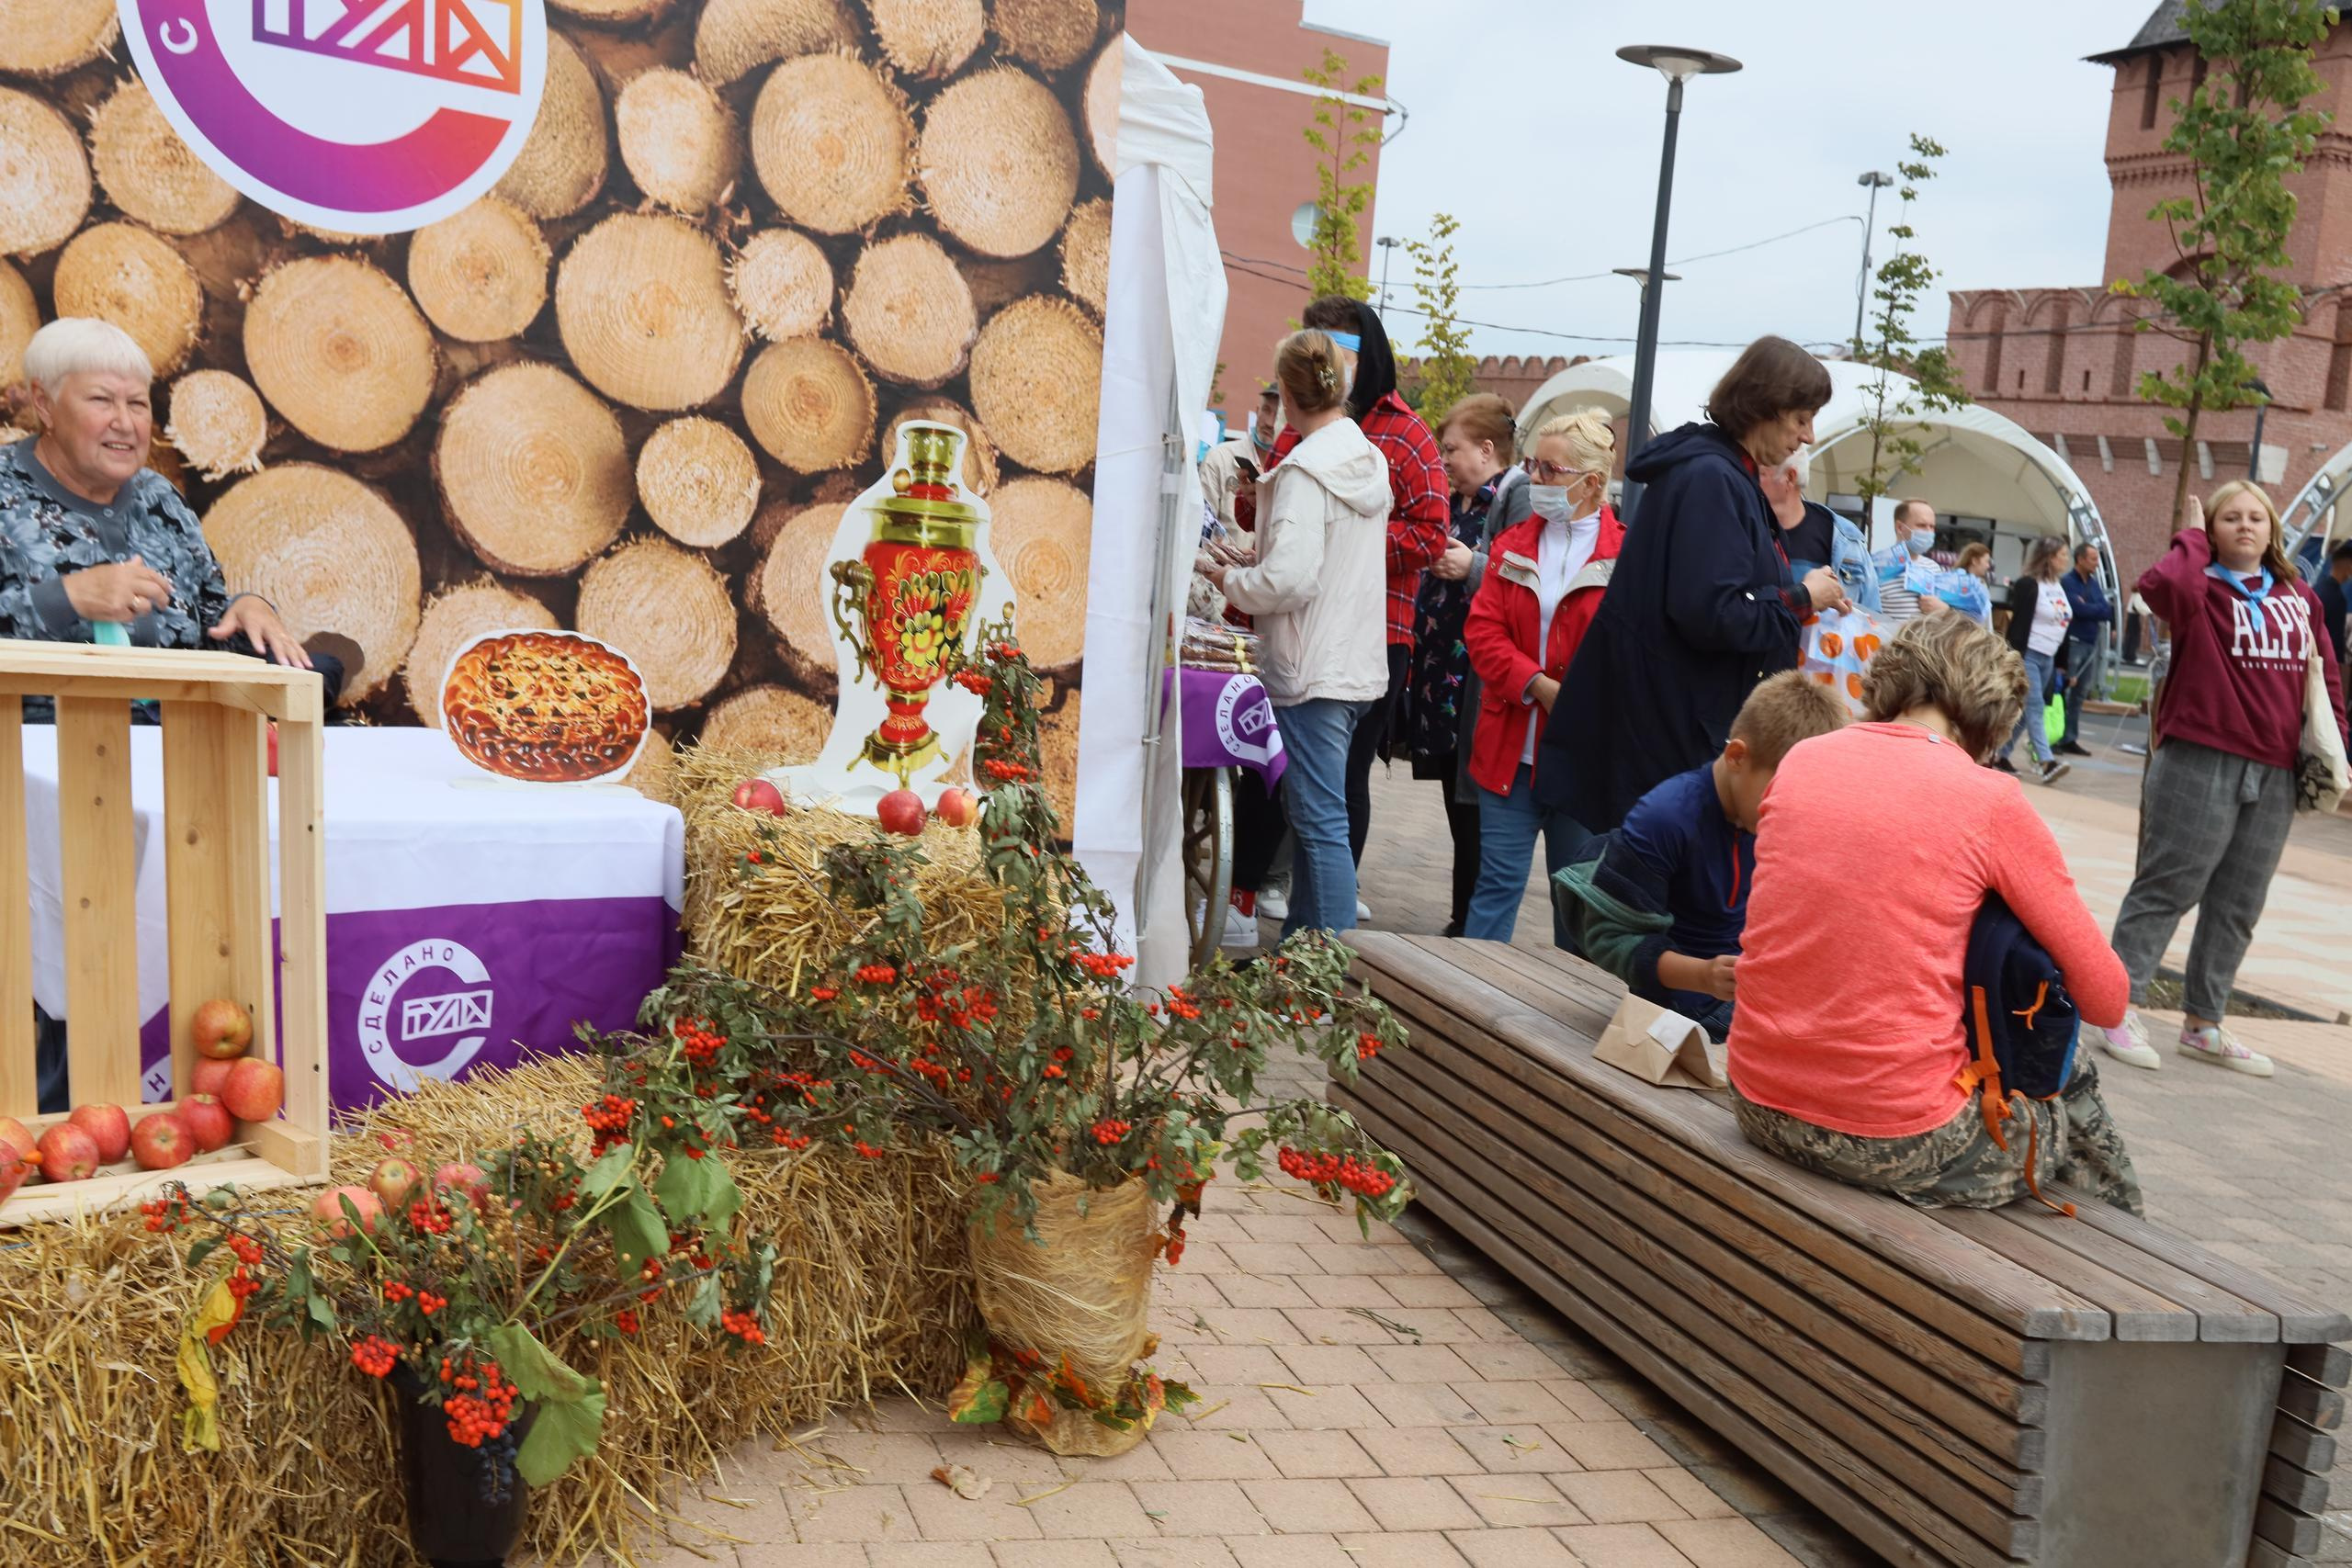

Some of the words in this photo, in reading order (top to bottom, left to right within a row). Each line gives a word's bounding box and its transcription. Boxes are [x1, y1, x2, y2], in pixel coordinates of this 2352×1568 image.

[1220, 675, 1252, 752] СДЕЛАНО
[365, 946, 455, 1054] СДЕЛАНО
[401, 989, 494, 1041] ТУЛА
